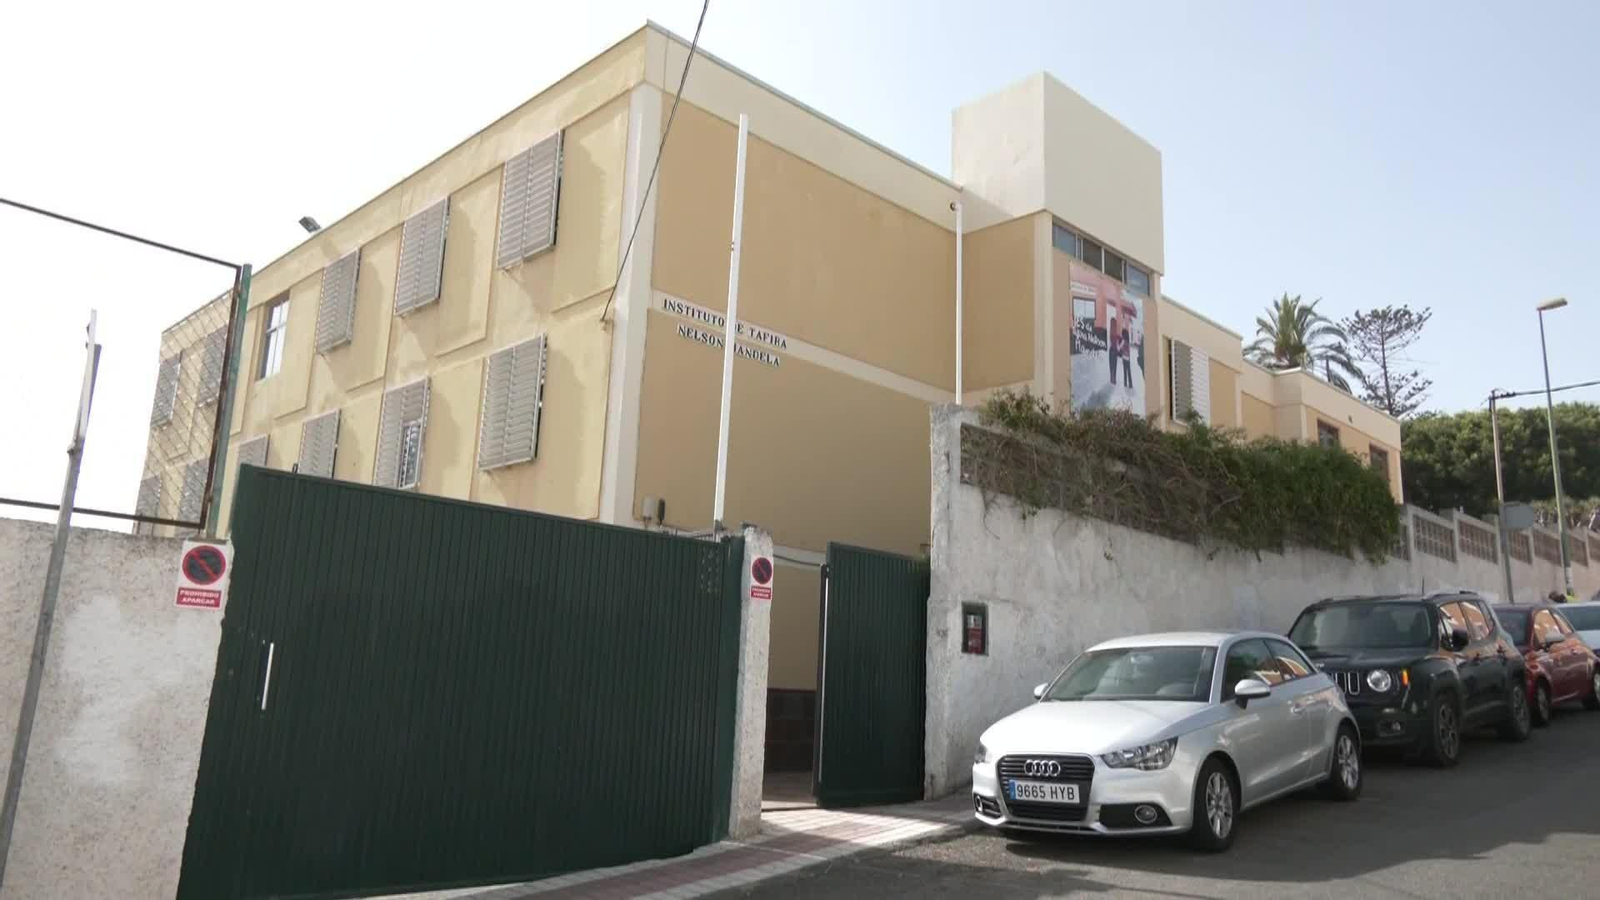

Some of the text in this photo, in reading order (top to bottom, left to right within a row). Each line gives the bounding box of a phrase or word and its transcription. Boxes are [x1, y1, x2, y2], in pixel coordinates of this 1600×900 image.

[663, 298, 725, 328] INSTITUTO
[749, 326, 787, 350] TAFIRA
[678, 324, 724, 349] NELSON
[180, 590, 219, 599] PROHIBIDO
[181, 597, 215, 605] APARCAR
[1016, 784, 1075, 801] 9665 HYB
